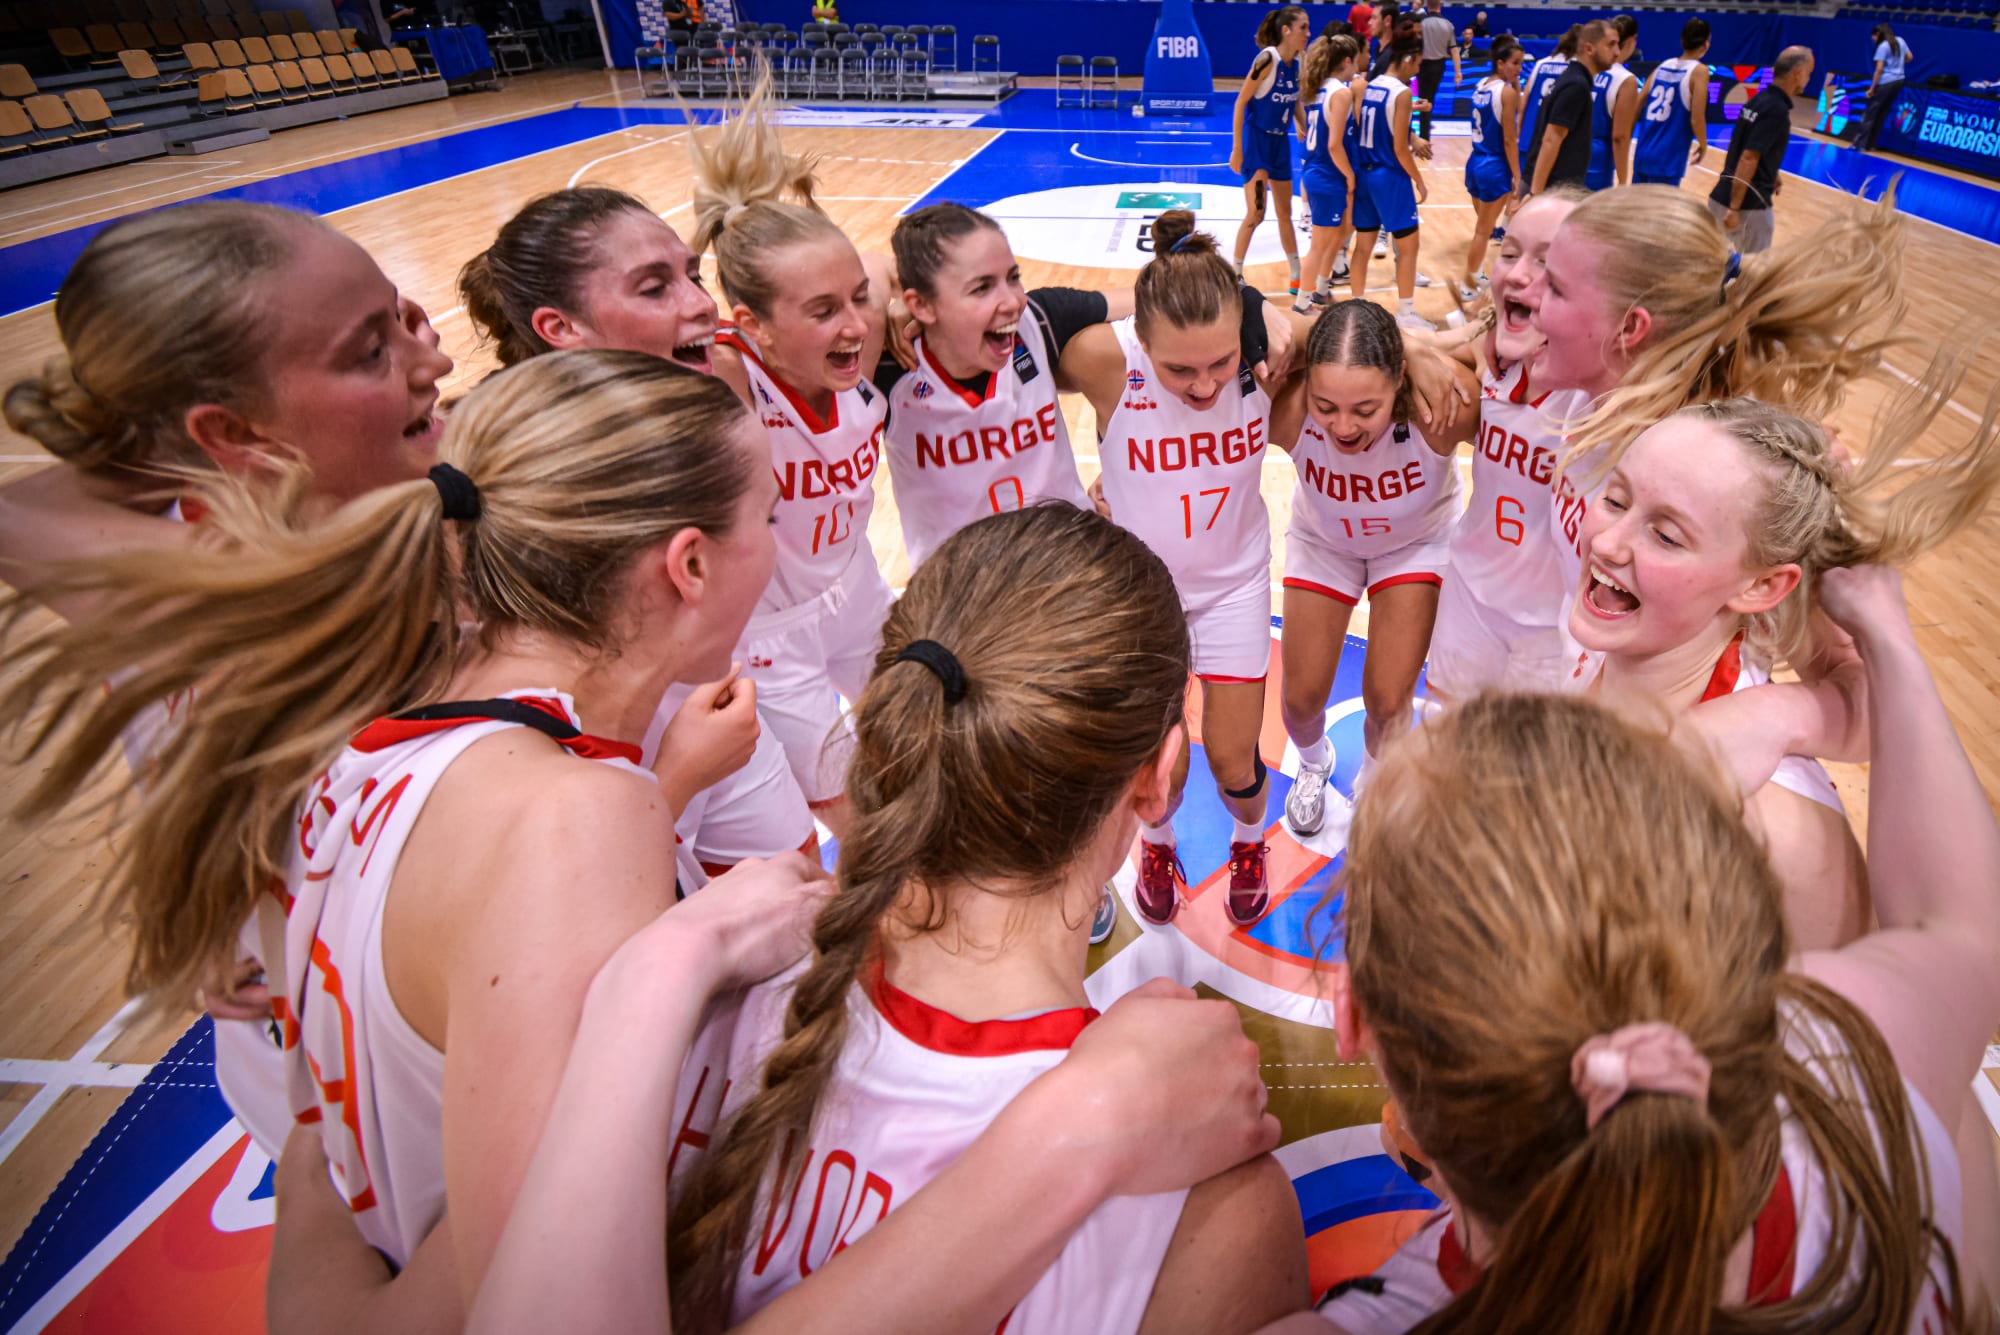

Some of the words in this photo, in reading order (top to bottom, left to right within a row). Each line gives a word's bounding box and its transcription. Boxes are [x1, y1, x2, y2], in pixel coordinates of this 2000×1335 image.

[1157, 35, 1199, 58] FIBA
[860, 117, 967, 127] ART
[1645, 84, 1676, 122] 23
[1925, 105, 1950, 122] FIBA
[1359, 105, 1377, 149] 11
[915, 401, 1056, 470] NORGE
[1127, 416, 1265, 474] NORGE
[1477, 419, 1557, 486] NORG
[1304, 457, 1426, 503] NORGE
[811, 501, 855, 557] 10
[1179, 486, 1231, 540] 17
[1339, 517, 1392, 539] 15
[1495, 495, 1526, 547] 6
